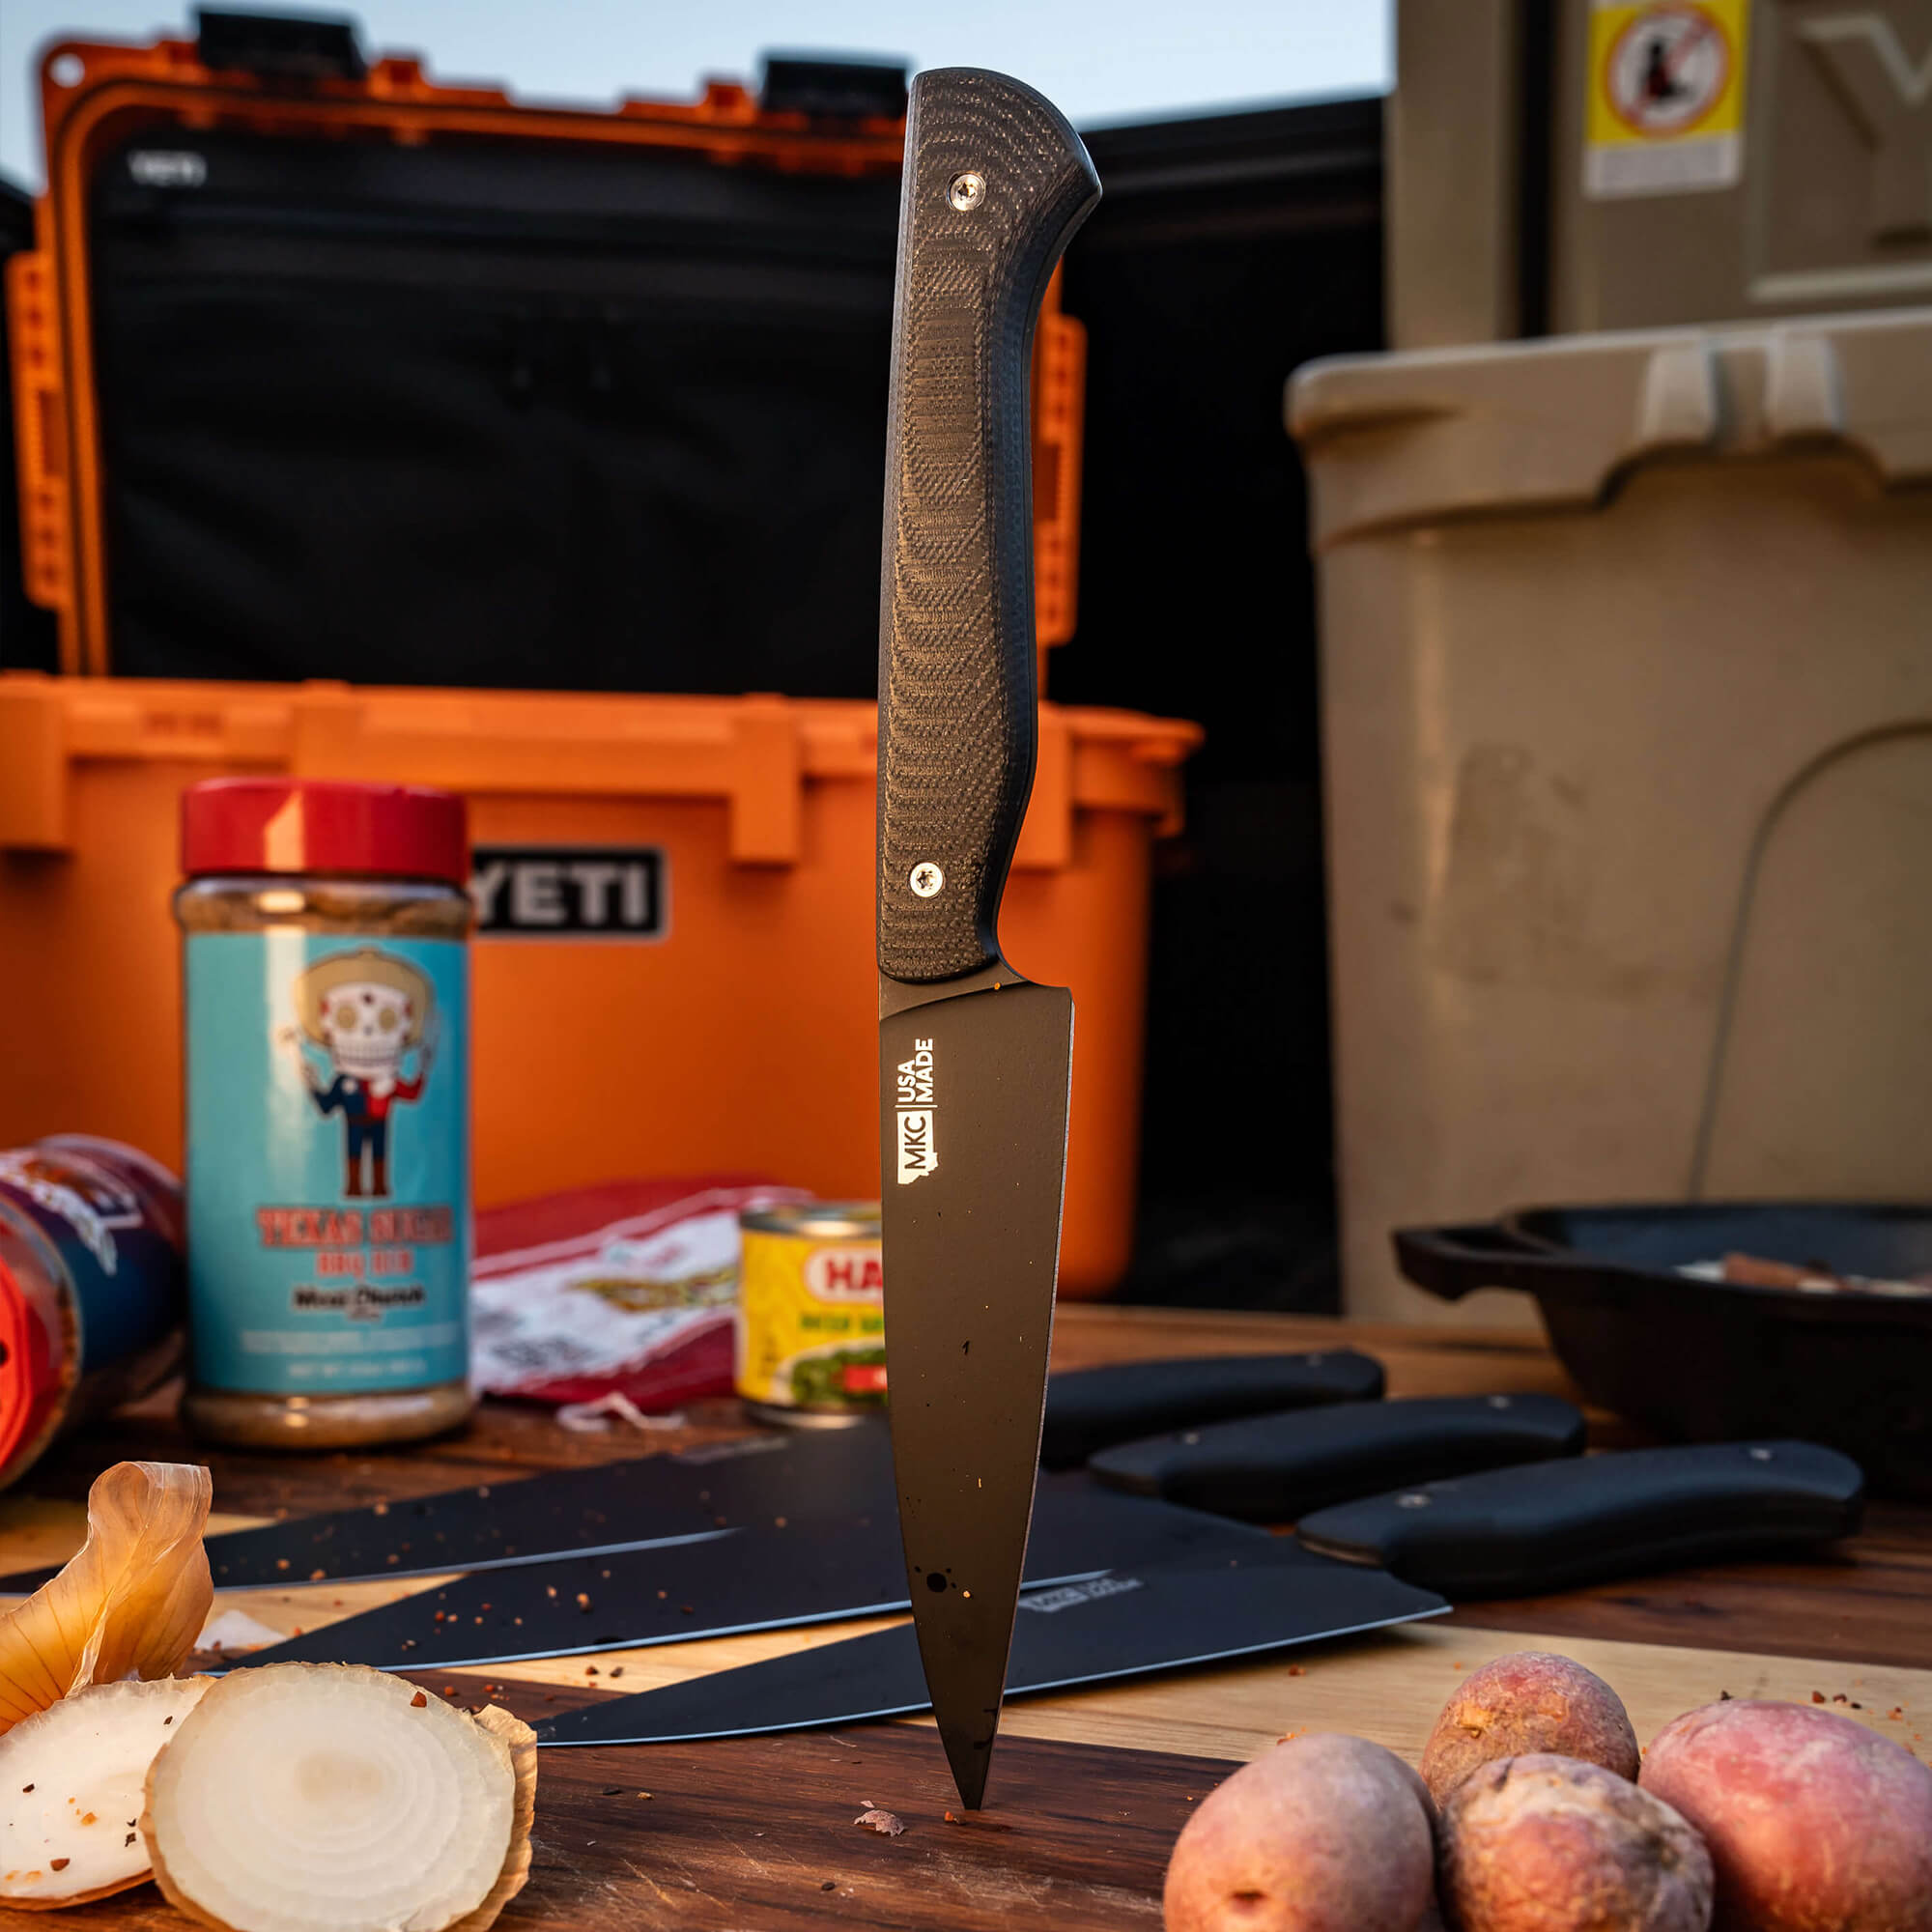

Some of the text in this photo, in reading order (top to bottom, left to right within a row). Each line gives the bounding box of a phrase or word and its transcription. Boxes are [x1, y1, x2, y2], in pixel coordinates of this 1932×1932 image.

[468, 861, 649, 924] YETI
[897, 1059, 917, 1102] USA
[915, 1038, 934, 1102] MADE
[904, 1116, 926, 1170] MKC
